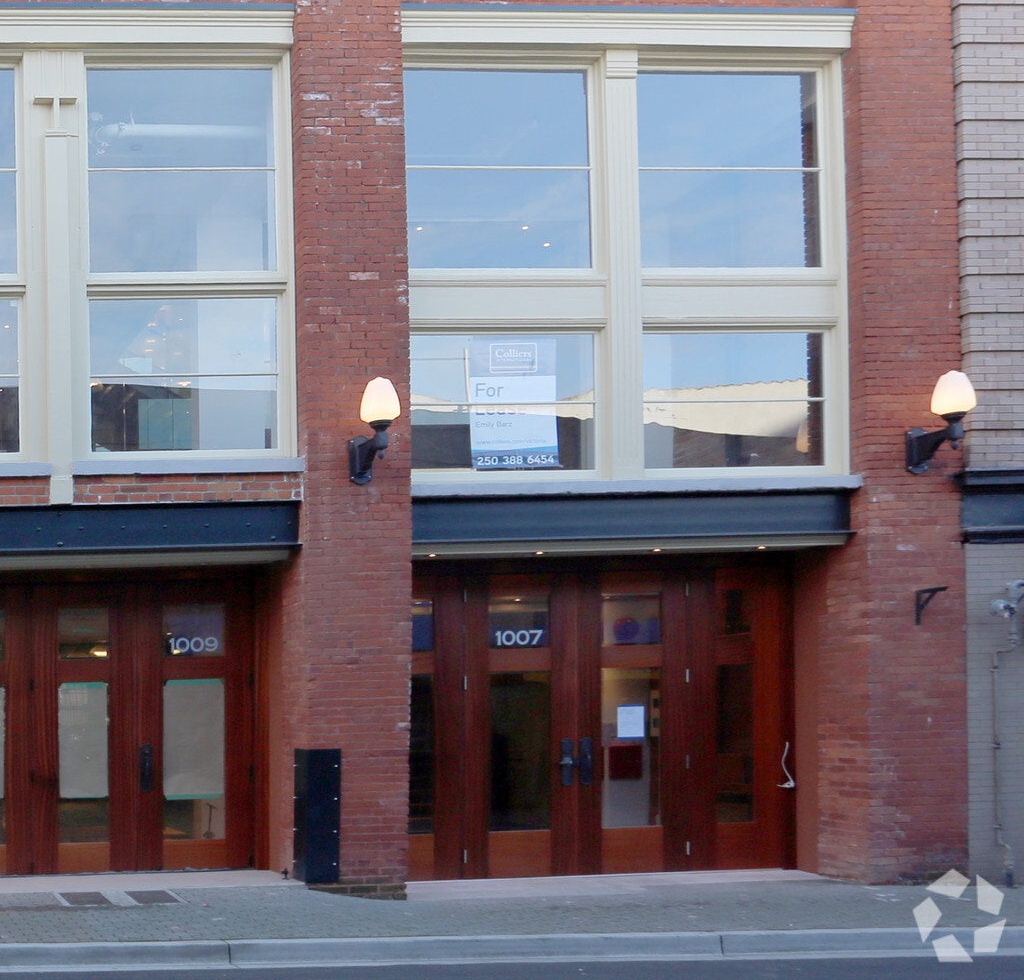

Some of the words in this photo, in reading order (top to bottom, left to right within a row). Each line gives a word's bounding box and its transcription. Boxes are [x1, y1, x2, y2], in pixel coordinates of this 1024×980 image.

[495, 348, 532, 358] Colliers
[475, 383, 504, 397] For
[477, 456, 499, 466] 250
[502, 455, 523, 465] 388
[527, 454, 554, 464] 6454
[169, 636, 219, 653] 1009
[495, 629, 543, 646] 1007
